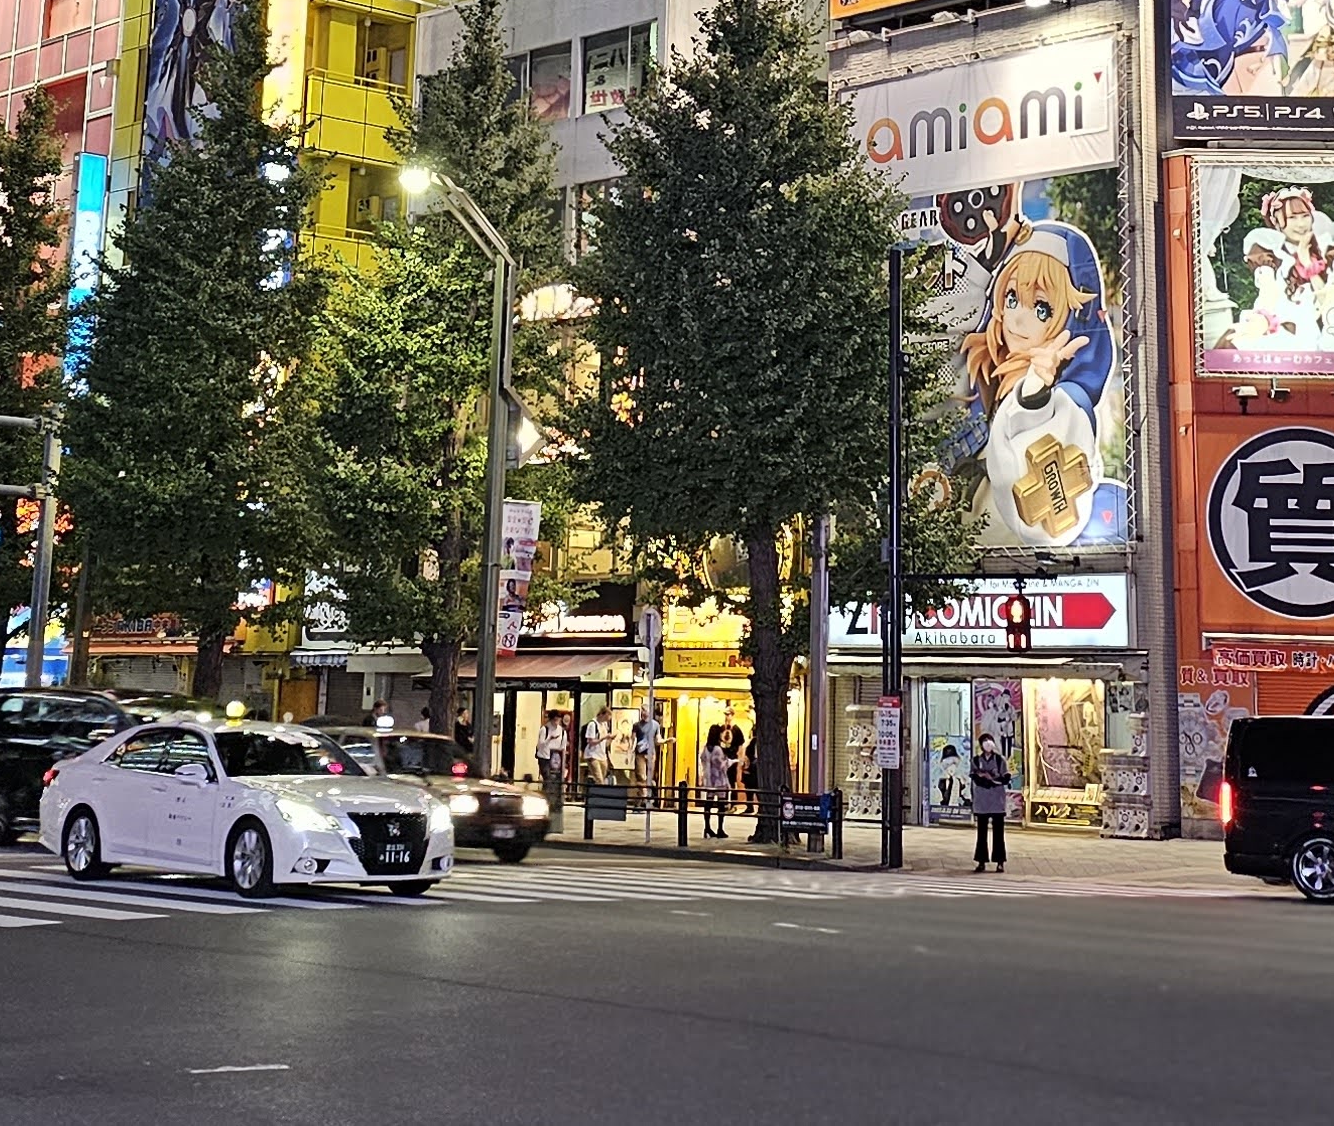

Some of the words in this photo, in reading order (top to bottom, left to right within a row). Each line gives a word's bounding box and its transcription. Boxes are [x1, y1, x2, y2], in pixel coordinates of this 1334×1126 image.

[1212, 104, 1264, 119] PS5
[1274, 105, 1325, 120] PS4
[866, 81, 1084, 164] amiami
[914, 631, 996, 645] Akihabara
[1215, 648, 1287, 670] 高価買取
[1034, 803, 1072, 820] ハルタ
